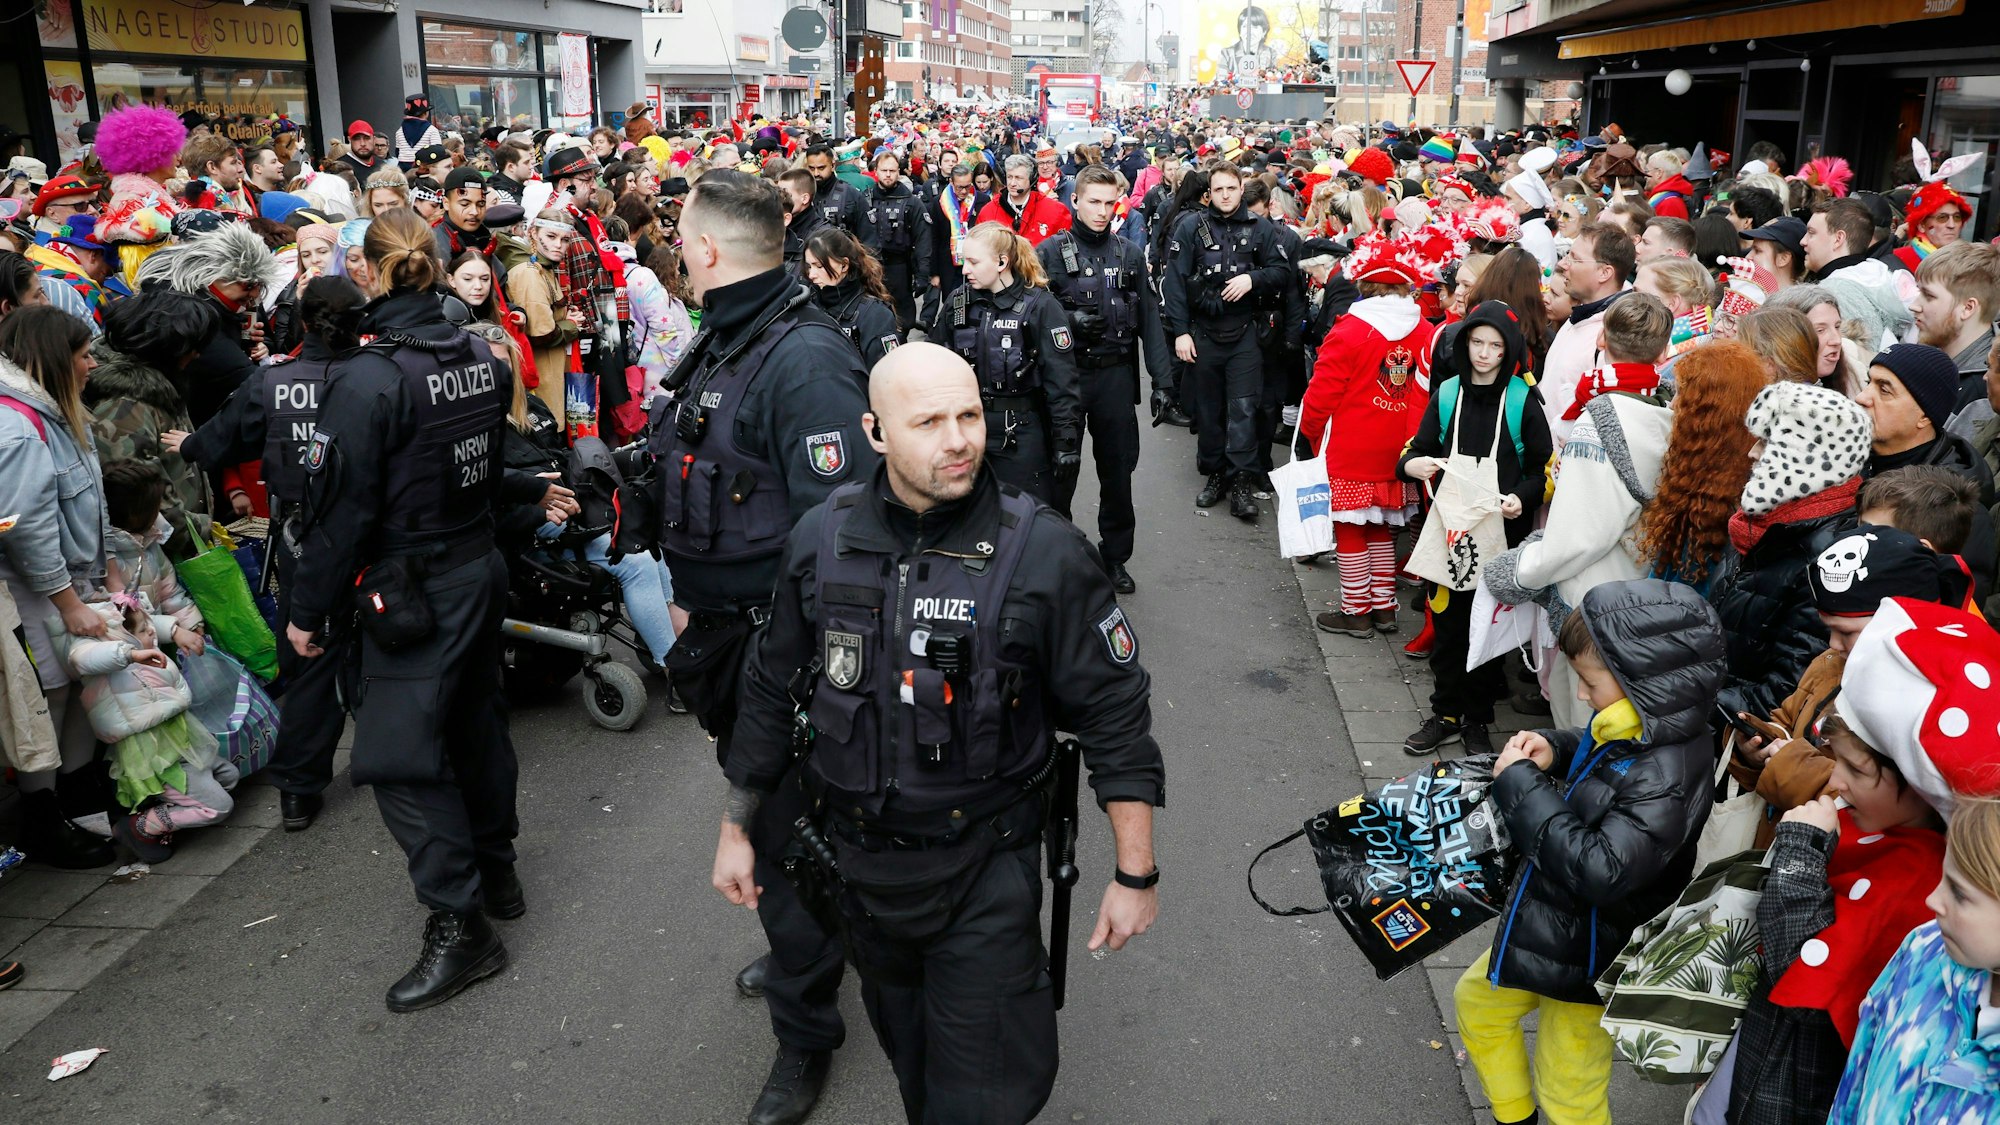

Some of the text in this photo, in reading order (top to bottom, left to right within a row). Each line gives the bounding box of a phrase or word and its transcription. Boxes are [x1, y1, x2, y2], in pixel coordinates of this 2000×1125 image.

[90, 5, 299, 47] NAGEL STUDIO
[1243, 60, 1255, 70] 30
[223, 100, 256, 114] beruht
[260, 99, 274, 114] auf
[213, 124, 223, 137] &
[992, 319, 1019, 330] POLIZEI
[426, 362, 496, 406] POLIZEI
[699, 391, 723, 409] OLIZEI
[807, 432, 840, 446] POLIZEI
[454, 432, 489, 465] NRW
[461, 458, 489, 488] 2611
[1297, 492, 1329, 506] ZEISS
[828, 633, 859, 649] POLIZEI
[1349, 803, 1408, 895] Mich
[1393, 909, 1417, 932] ALDI
